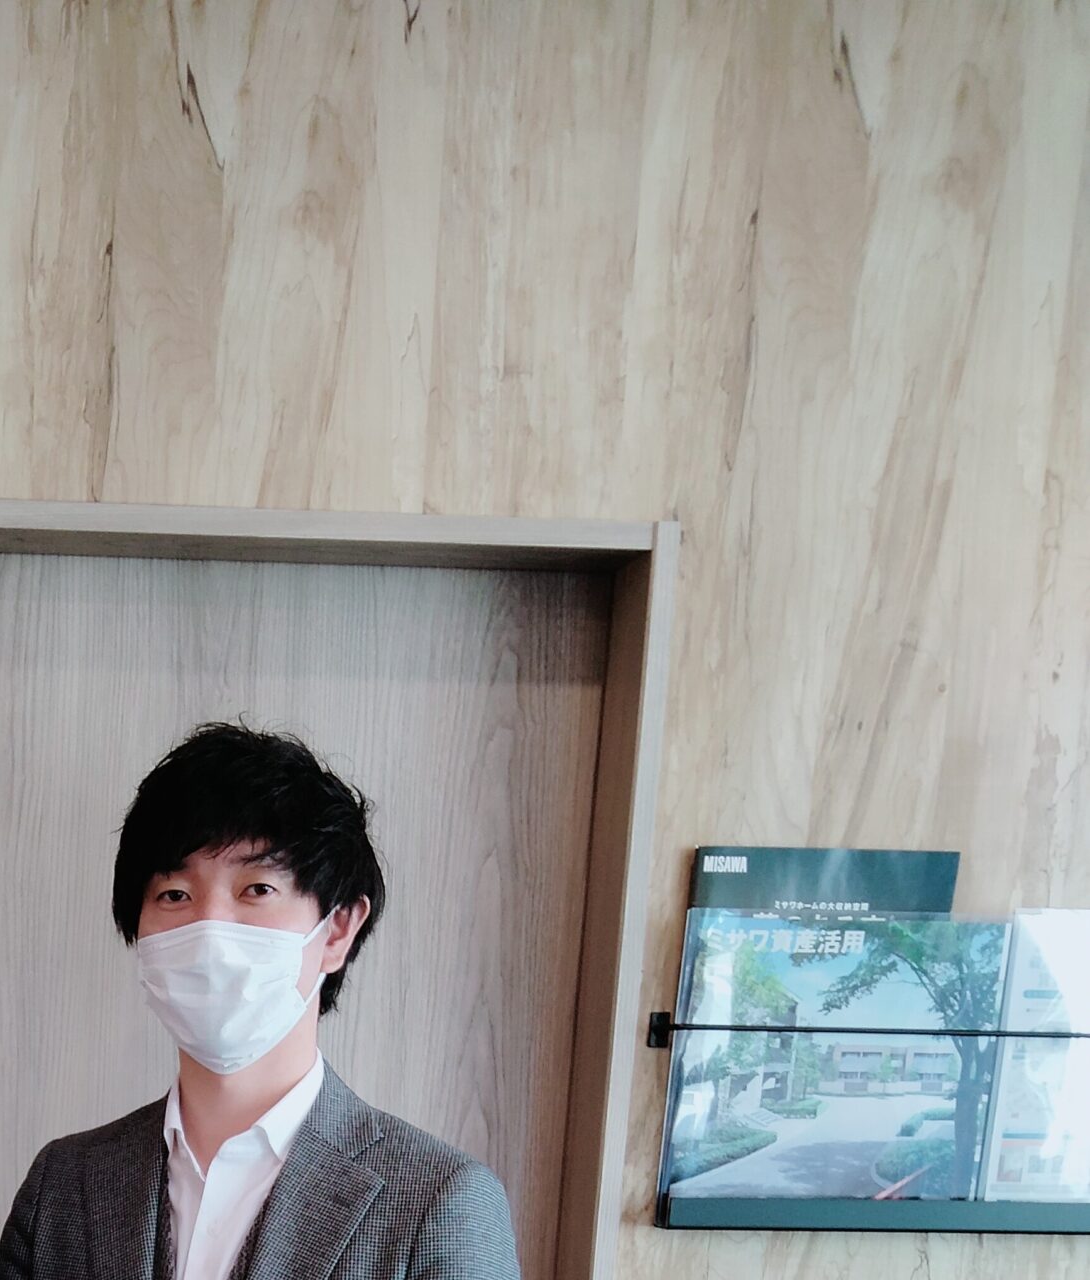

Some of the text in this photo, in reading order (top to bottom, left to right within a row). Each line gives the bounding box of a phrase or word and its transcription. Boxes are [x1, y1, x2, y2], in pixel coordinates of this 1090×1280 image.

[703, 855, 748, 874] MISAWA
[707, 929, 866, 954] ミサワ資産活用
